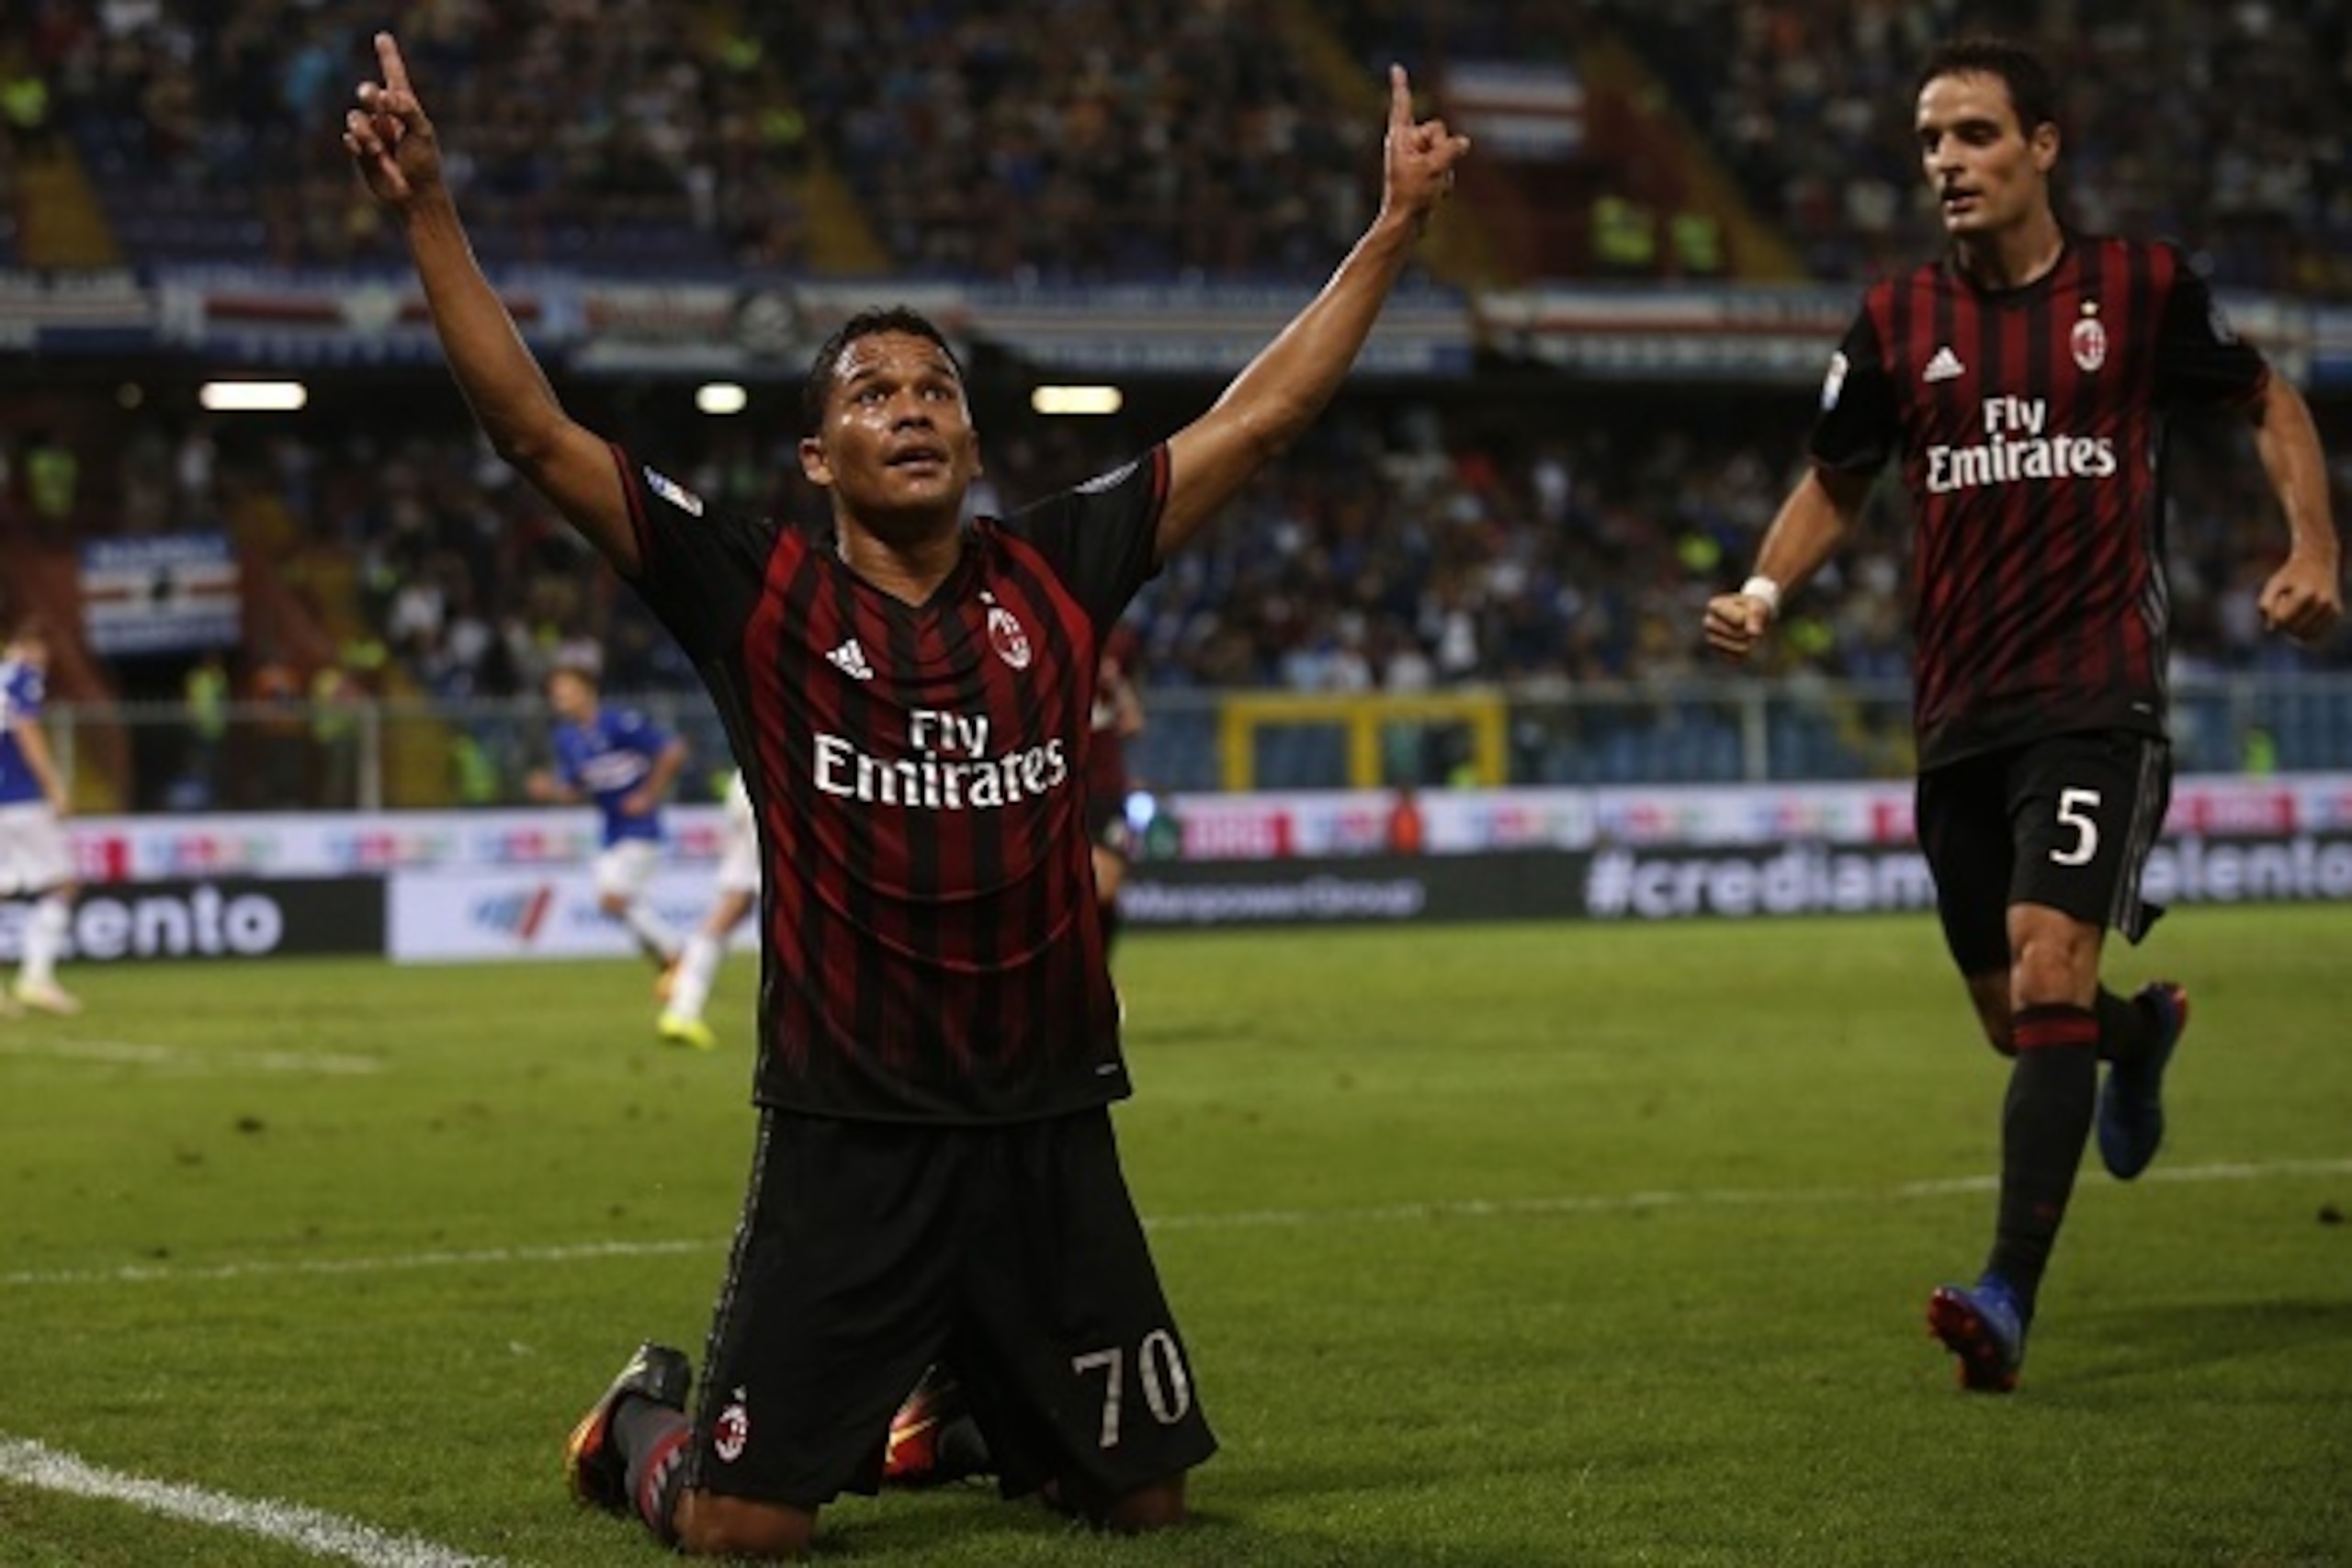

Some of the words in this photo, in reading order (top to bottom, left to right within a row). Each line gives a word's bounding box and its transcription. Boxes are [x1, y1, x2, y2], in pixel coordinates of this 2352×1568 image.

[1982, 394, 2046, 435] Fly
[1925, 432, 2118, 493] Emirates
[910, 709, 989, 758] Fly
[813, 731, 1069, 810] Emirates
[2049, 786, 2101, 864] 5
[1070, 1328, 1191, 1448] 70
